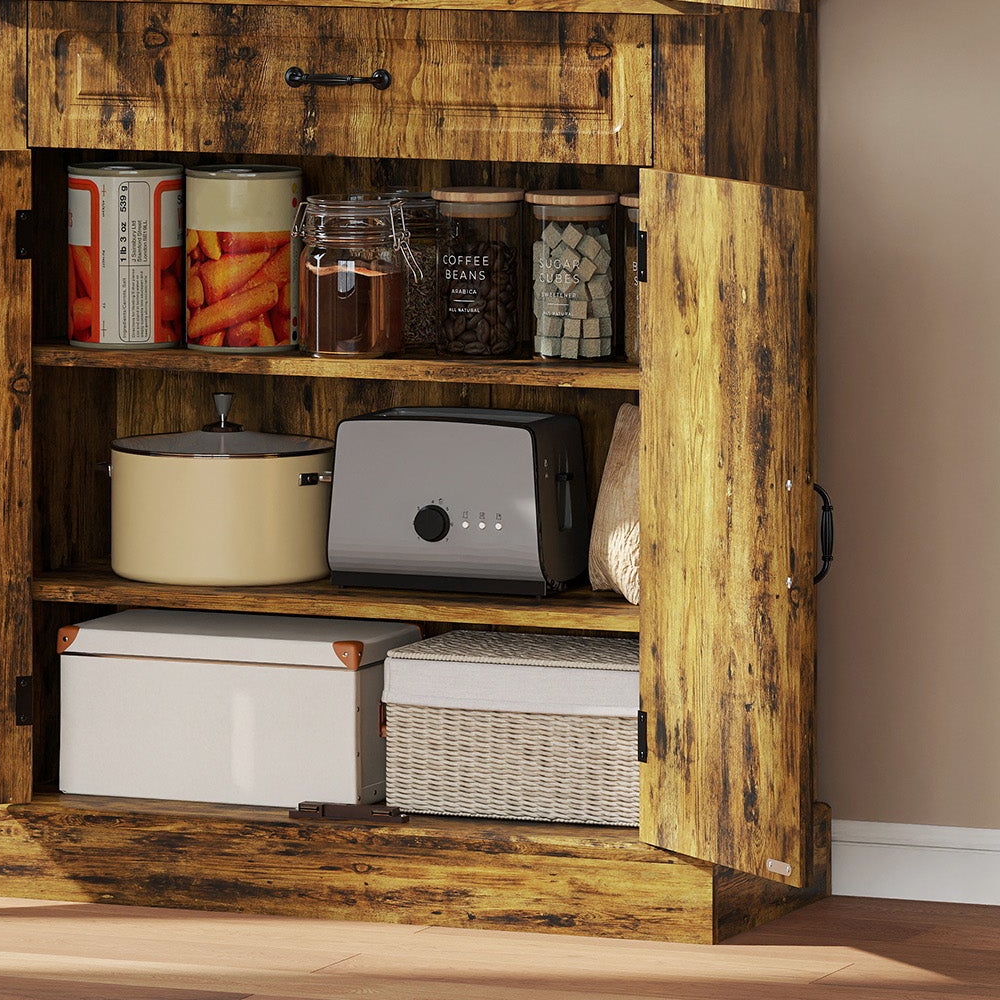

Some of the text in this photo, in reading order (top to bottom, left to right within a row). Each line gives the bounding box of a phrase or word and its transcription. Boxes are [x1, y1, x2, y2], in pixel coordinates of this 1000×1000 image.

[121, 221, 127, 233] oz
[120, 246, 127, 255] lb
[442, 255, 489, 266] COFFEE
[539, 258, 580, 269] SUGAR
[445, 270, 486, 281] BEANS
[539, 273, 580, 284] CUBES
